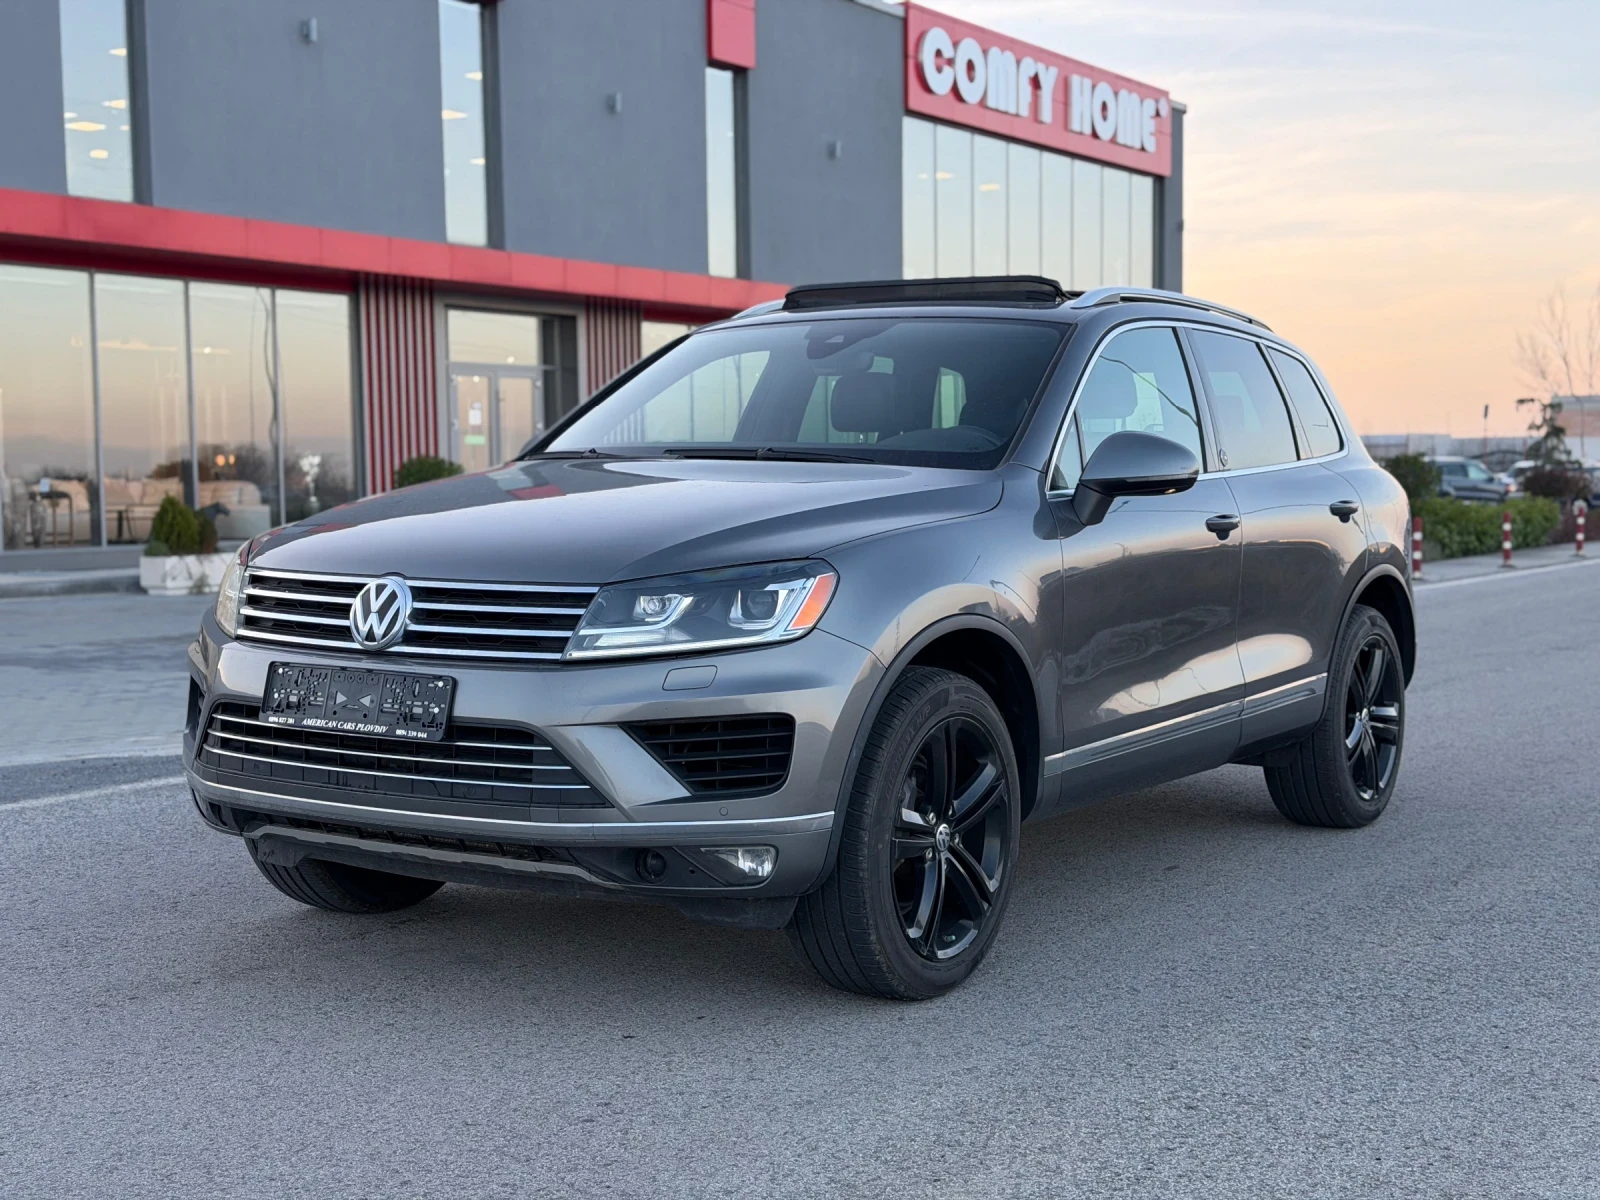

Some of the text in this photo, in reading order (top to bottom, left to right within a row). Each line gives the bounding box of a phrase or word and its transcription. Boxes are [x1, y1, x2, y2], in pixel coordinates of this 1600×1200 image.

[919, 27, 1157, 153] COMFY HOME
[301, 718, 389, 734] AMERICAN CARS PLOVDIV
